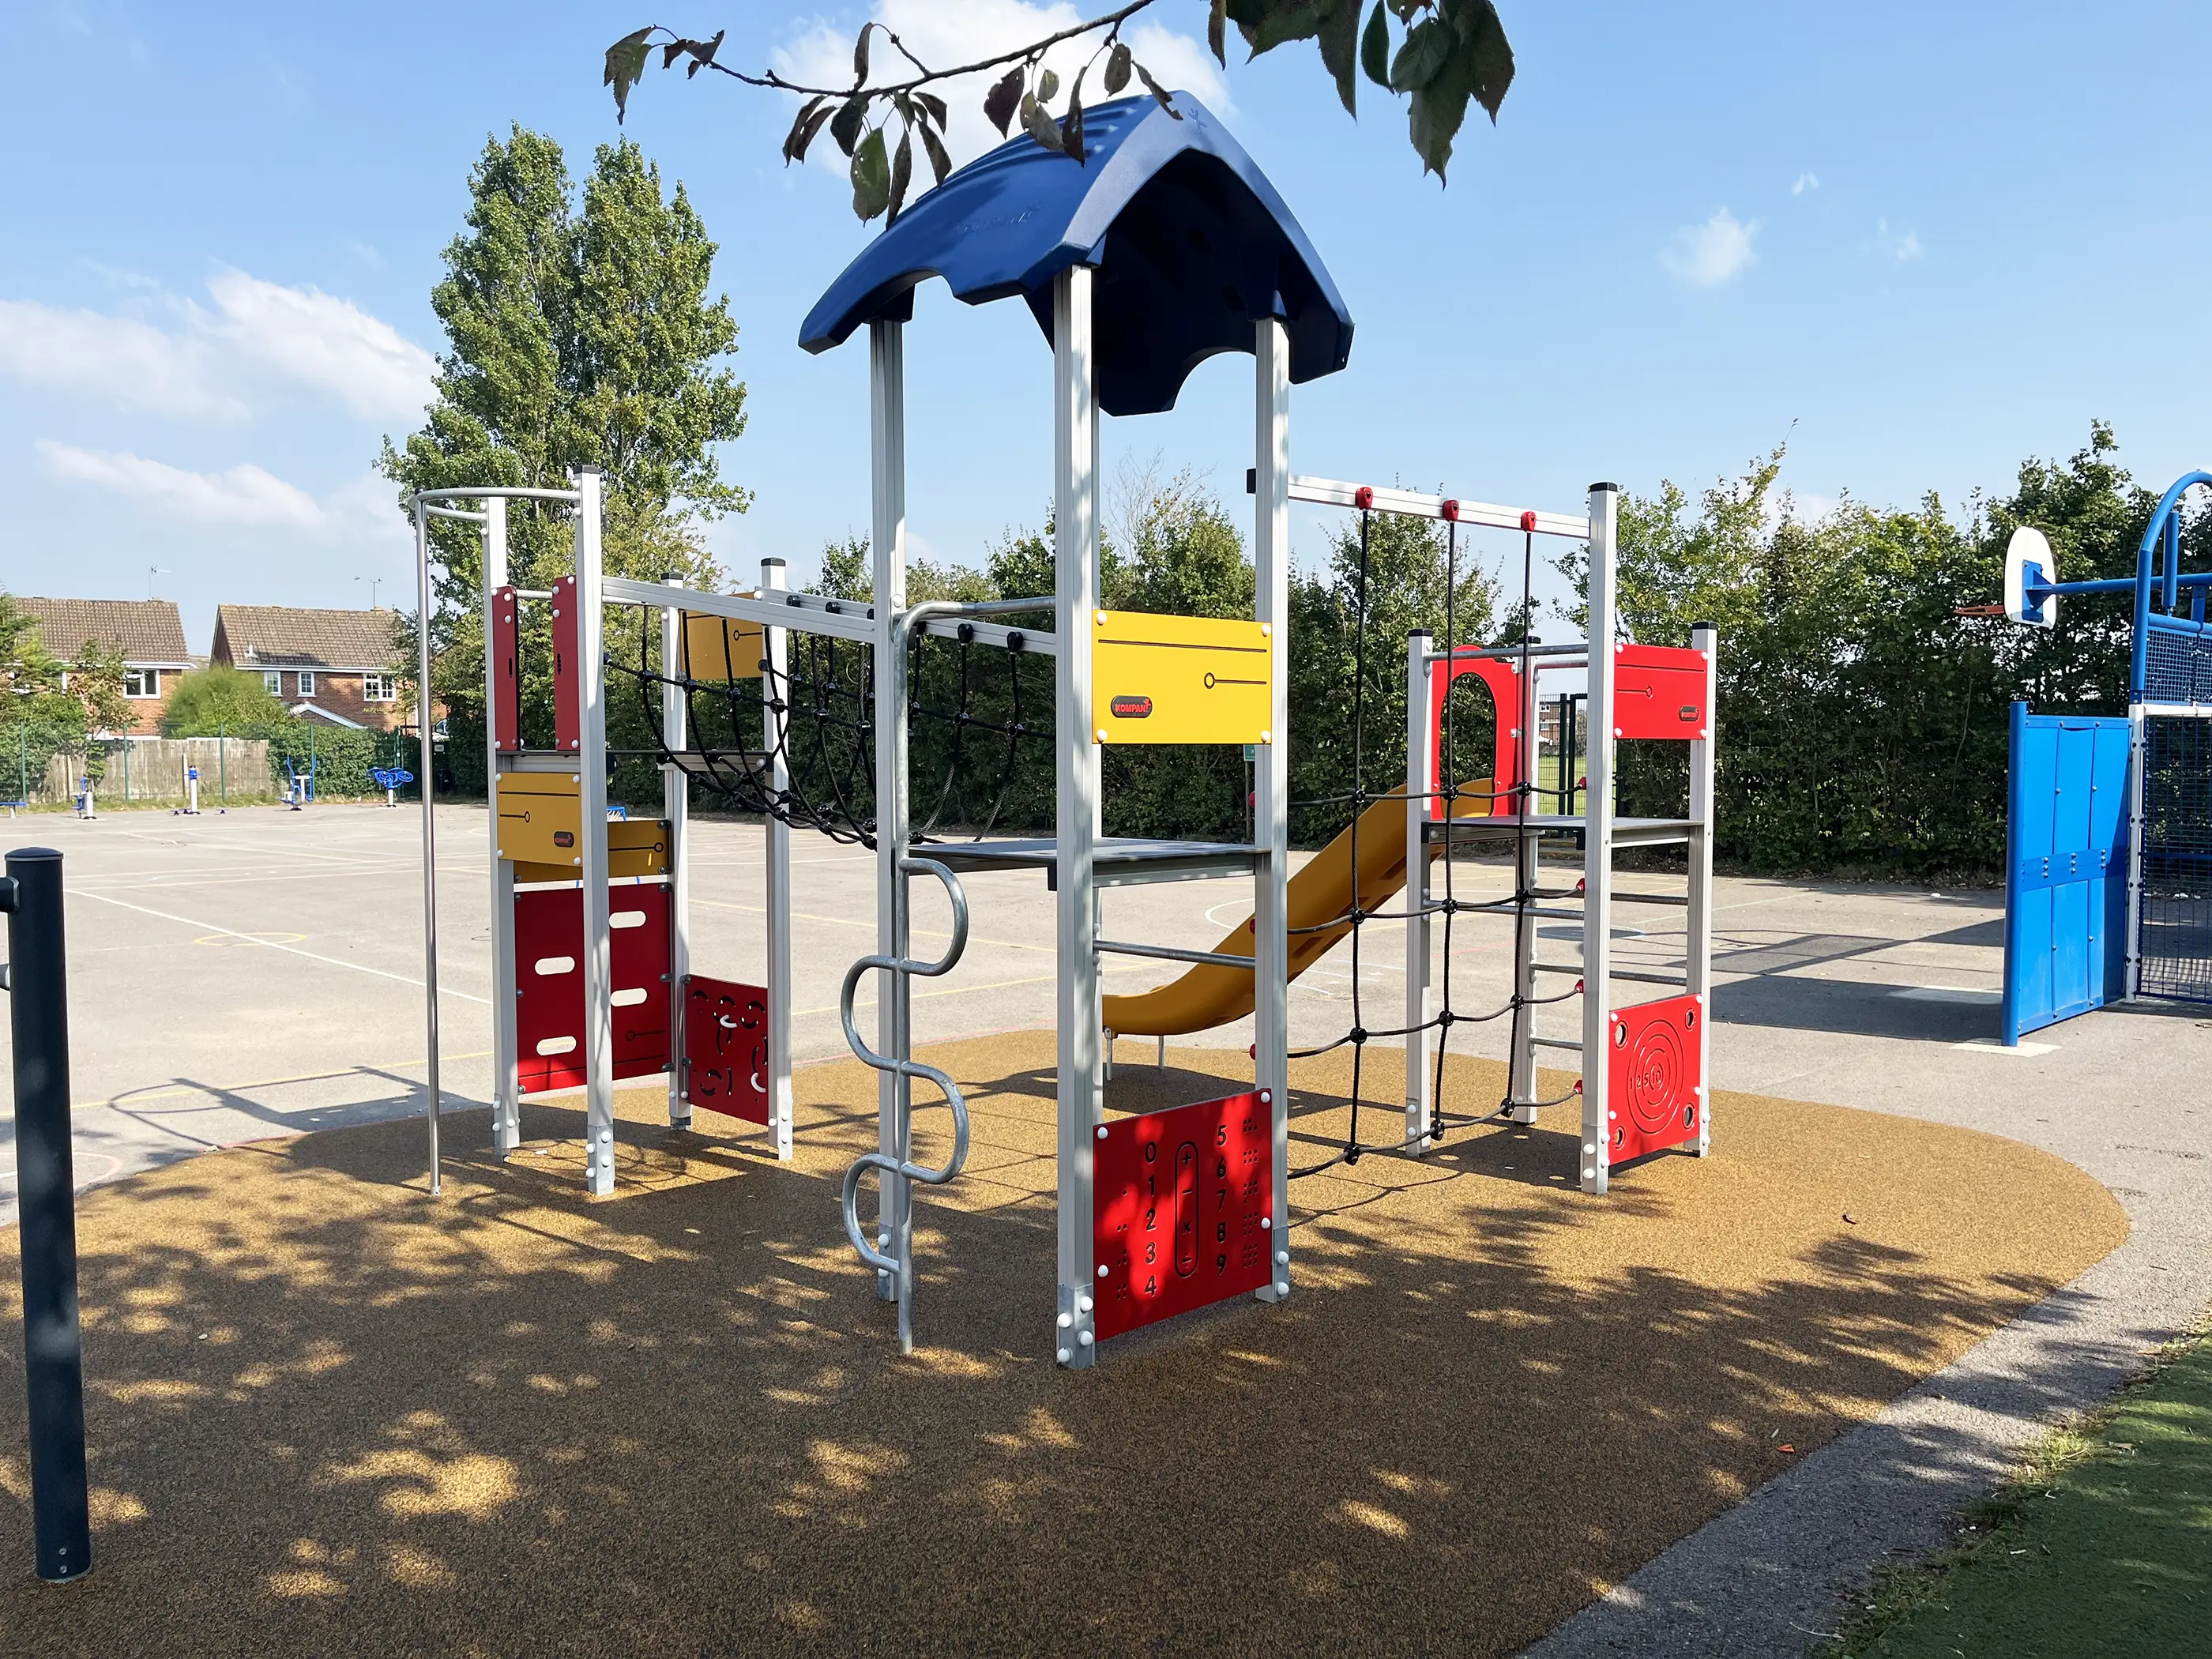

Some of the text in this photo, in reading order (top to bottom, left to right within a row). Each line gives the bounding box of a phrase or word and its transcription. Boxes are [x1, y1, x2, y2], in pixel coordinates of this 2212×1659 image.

[1115, 704, 1146, 713] KOMPAN
[1636, 1075, 1642, 1089] 2
[1644, 1073, 1650, 1087] 5
[1651, 1070, 1661, 1084] 10
[1217, 1124, 1227, 1146] 5
[1145, 1141, 1157, 1164] 0
[1217, 1157, 1226, 1179] 6
[1148, 1174, 1155, 1197] 1
[1217, 1188, 1226, 1212] 7
[1146, 1209, 1157, 1232] 2
[1217, 1221, 1226, 1243] 8
[1146, 1242, 1156, 1265] 3
[1217, 1254, 1226, 1276] 9
[1144, 1274, 1157, 1297] 4
